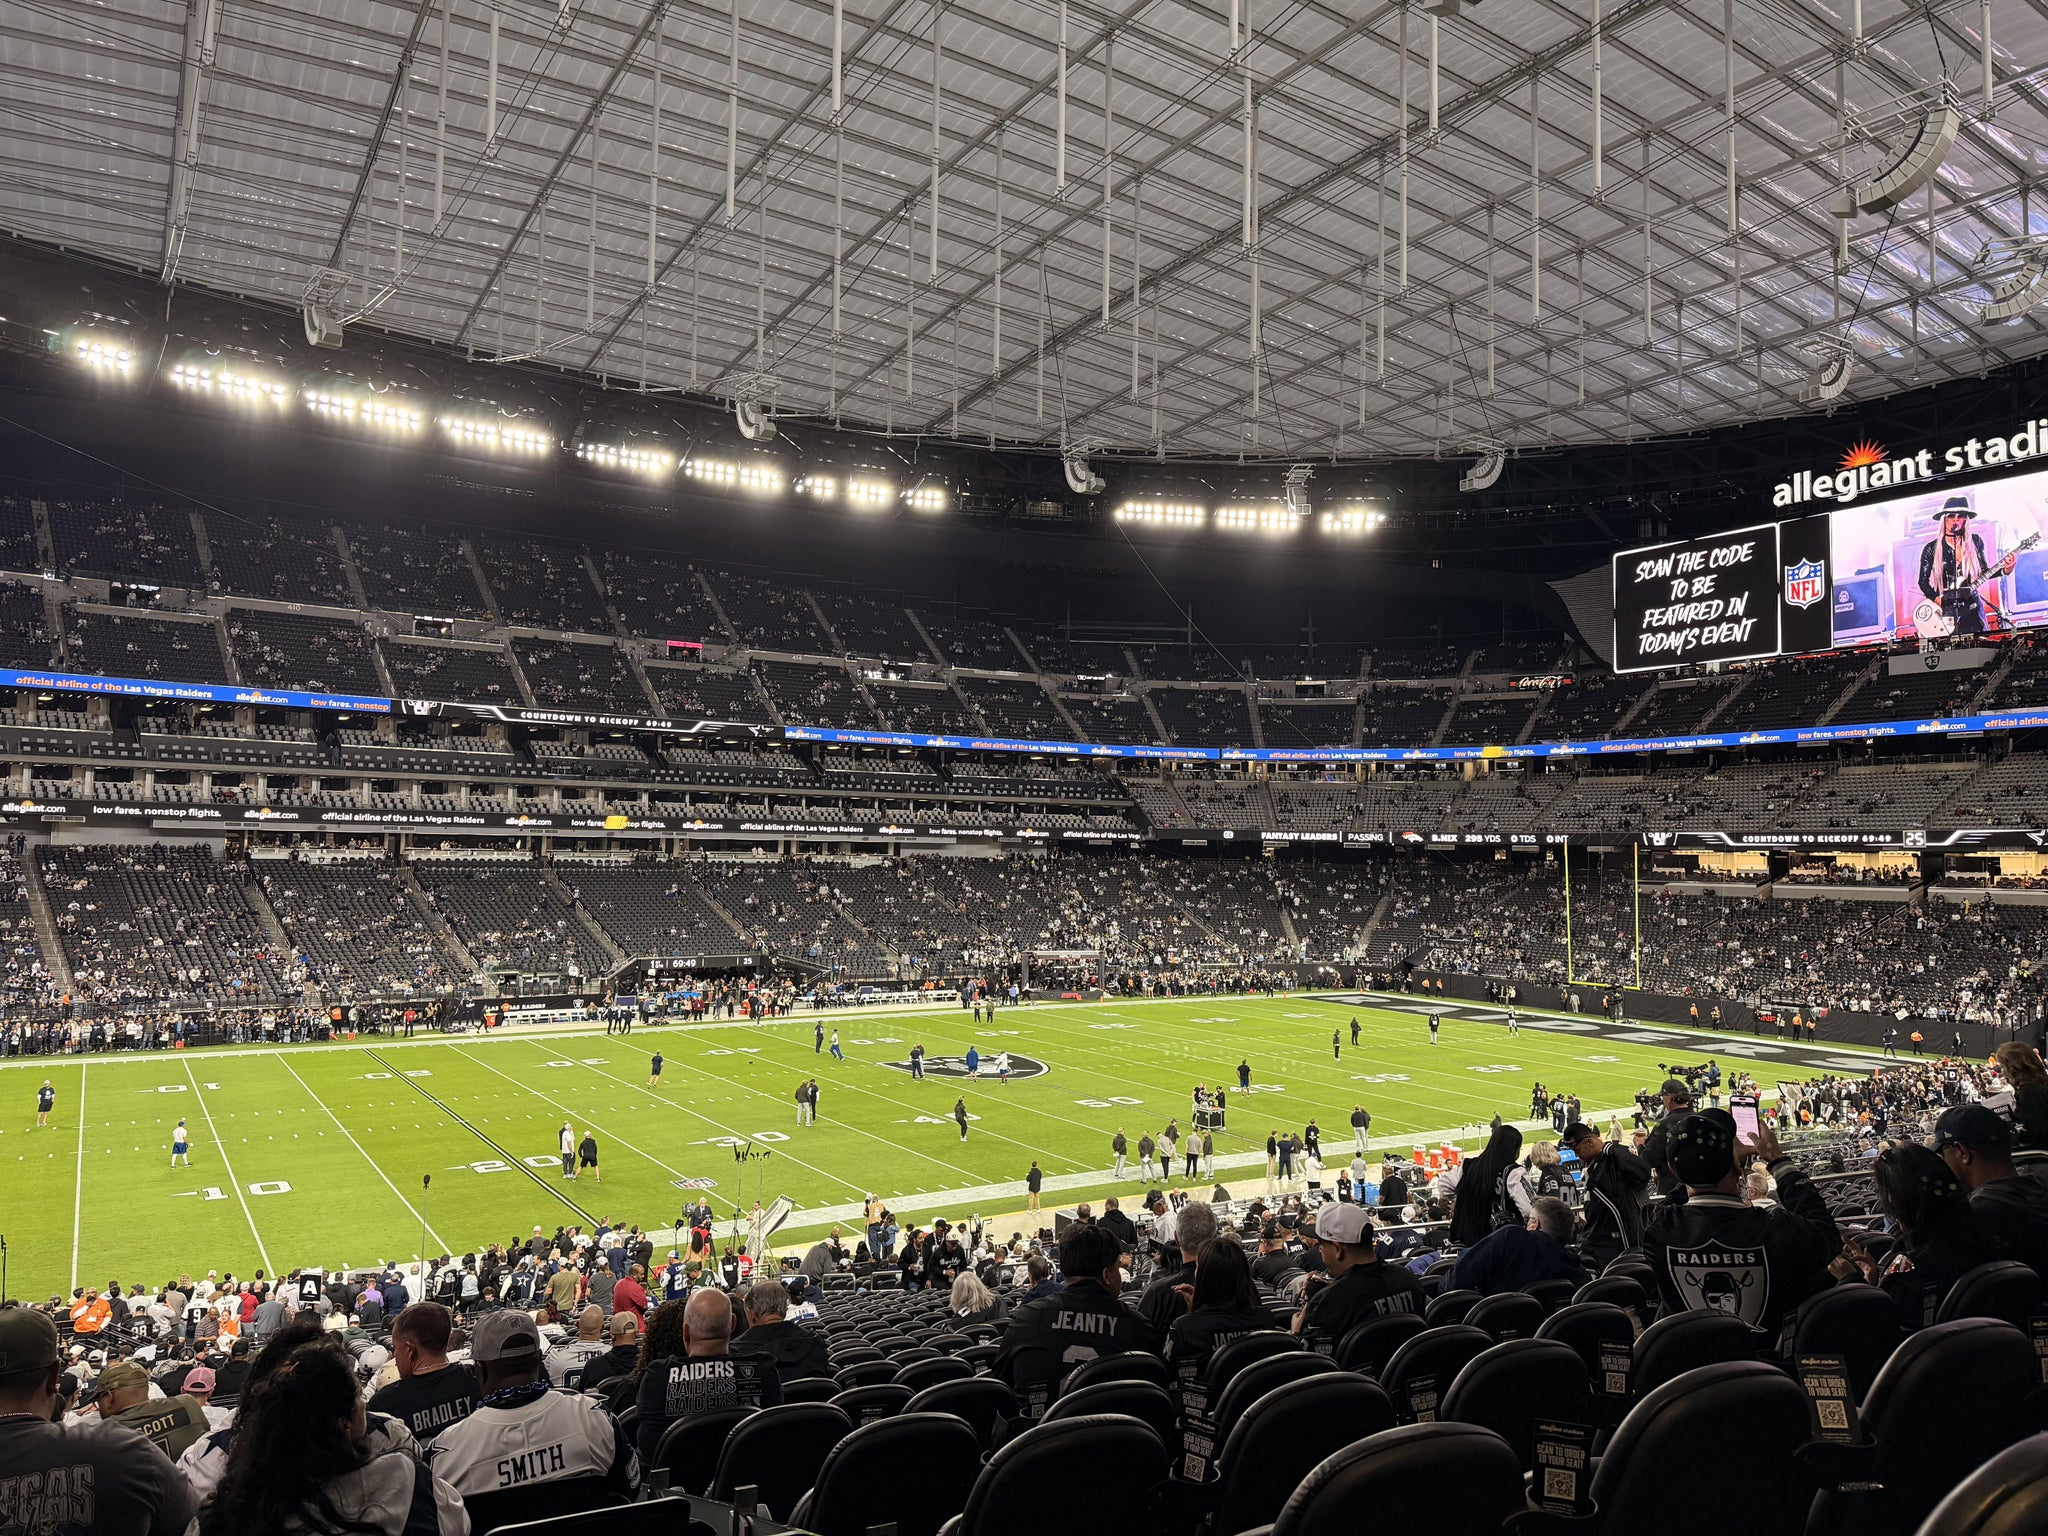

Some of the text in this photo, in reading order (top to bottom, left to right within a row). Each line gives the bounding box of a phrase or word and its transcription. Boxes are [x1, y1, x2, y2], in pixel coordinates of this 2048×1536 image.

[1773, 418, 2048, 507] allegiant stadi
[1634, 542, 1755, 583] SCAN THE CODE
[1671, 575, 1717, 601] TO BE
[1790, 579, 1819, 602] NFL
[1643, 591, 1748, 629] FEATURED IN
[1639, 618, 1757, 655] TODAY'S EVENT
[16, 676, 212, 698] official airline of the Las Vegas Raiders
[236, 691, 288, 703] allegiant.com
[311, 698, 389, 711] low fares. nonstop
[521, 712, 581, 722] COUNTDOWN
[600, 717, 639, 726] KICKOFF
[1985, 718, 2017, 727] official
[1835, 729, 1867, 738] nonstop
[1869, 727, 1896, 736] flights.
[1917, 722, 1966, 733] allegiant.com
[1676, 740, 1696, 748] Vegas
[1698, 738, 1722, 746] Raiders
[2, 803, 66, 814] allegiant.com
[93, 805, 221, 819] low fares. nonstop flights.
[245, 810, 298, 820] allegiant.com
[322, 812, 485, 825] official airline of the Las Vegas Raiders
[505, 817, 552, 827] allegiant.com
[571, 819, 665, 830] low flights.
[740, 823, 763, 831] official
[818, 825, 838, 834] Vegas
[958, 829, 982, 837] nonstop
[1261, 832, 1299, 840] FANTASY
[1348, 833, 1384, 841] PASSING
[1743, 835, 1891, 843] COUNTDOWN TO KICKOFF 69:49
[1905, 832, 1924, 846] 25
[672, 959, 696, 968] 69:49
[743, 957, 752, 965] 25
[1677, 1252, 1756, 1264] RAIDERS
[1051, 1310, 1118, 1337] JEANTY
[669, 1361, 735, 1383] RAIDERS
[666, 1377, 736, 1400] RAIDERS
[413, 1396, 471, 1431] BRADLEY
[1537, 1444, 1553, 1455] SCAN
[1555, 1446, 1563, 1457] TO
[497, 1443, 566, 1488] SMITH
[1539, 1454, 1546, 1464] TO
